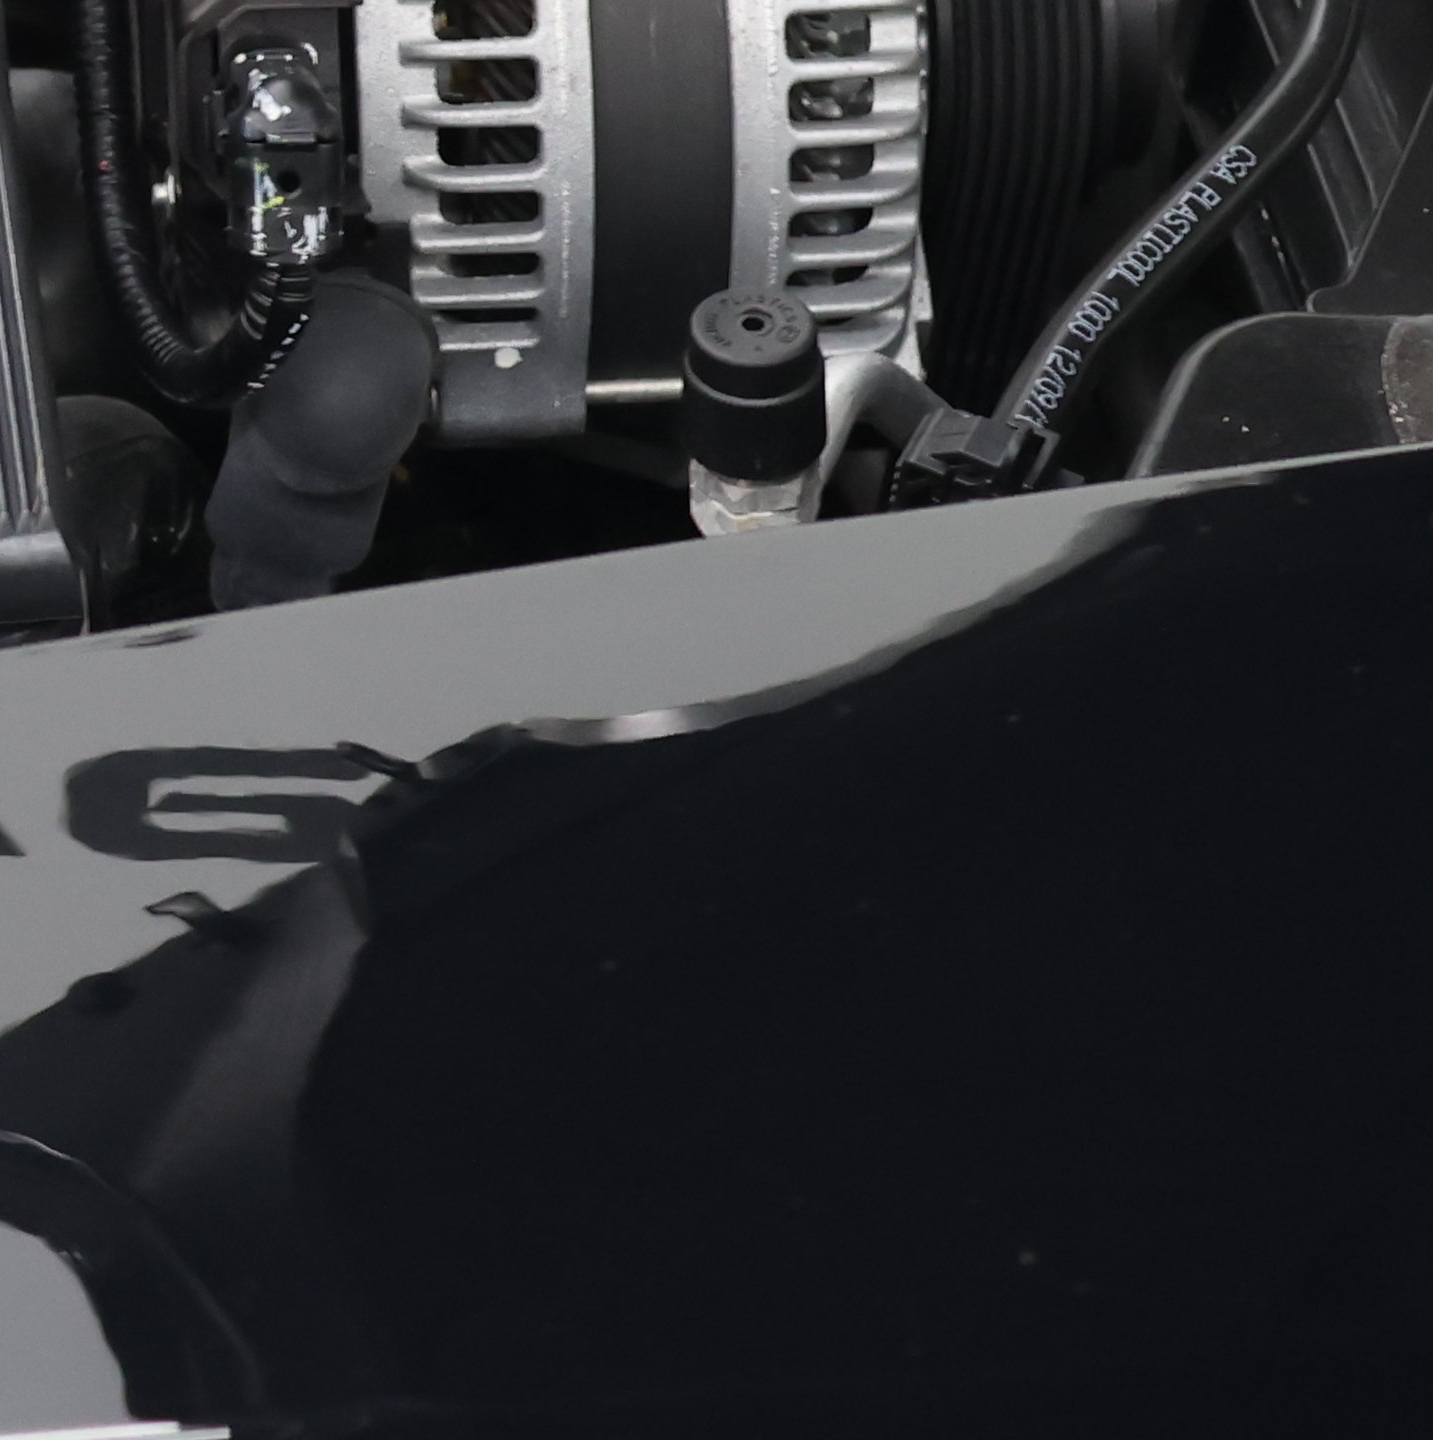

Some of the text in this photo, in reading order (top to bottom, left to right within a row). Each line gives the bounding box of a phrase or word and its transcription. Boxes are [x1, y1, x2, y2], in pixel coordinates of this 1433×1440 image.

[1008, 145, 1258, 430] CSA PLASTICOOL 1000 12/09/1
